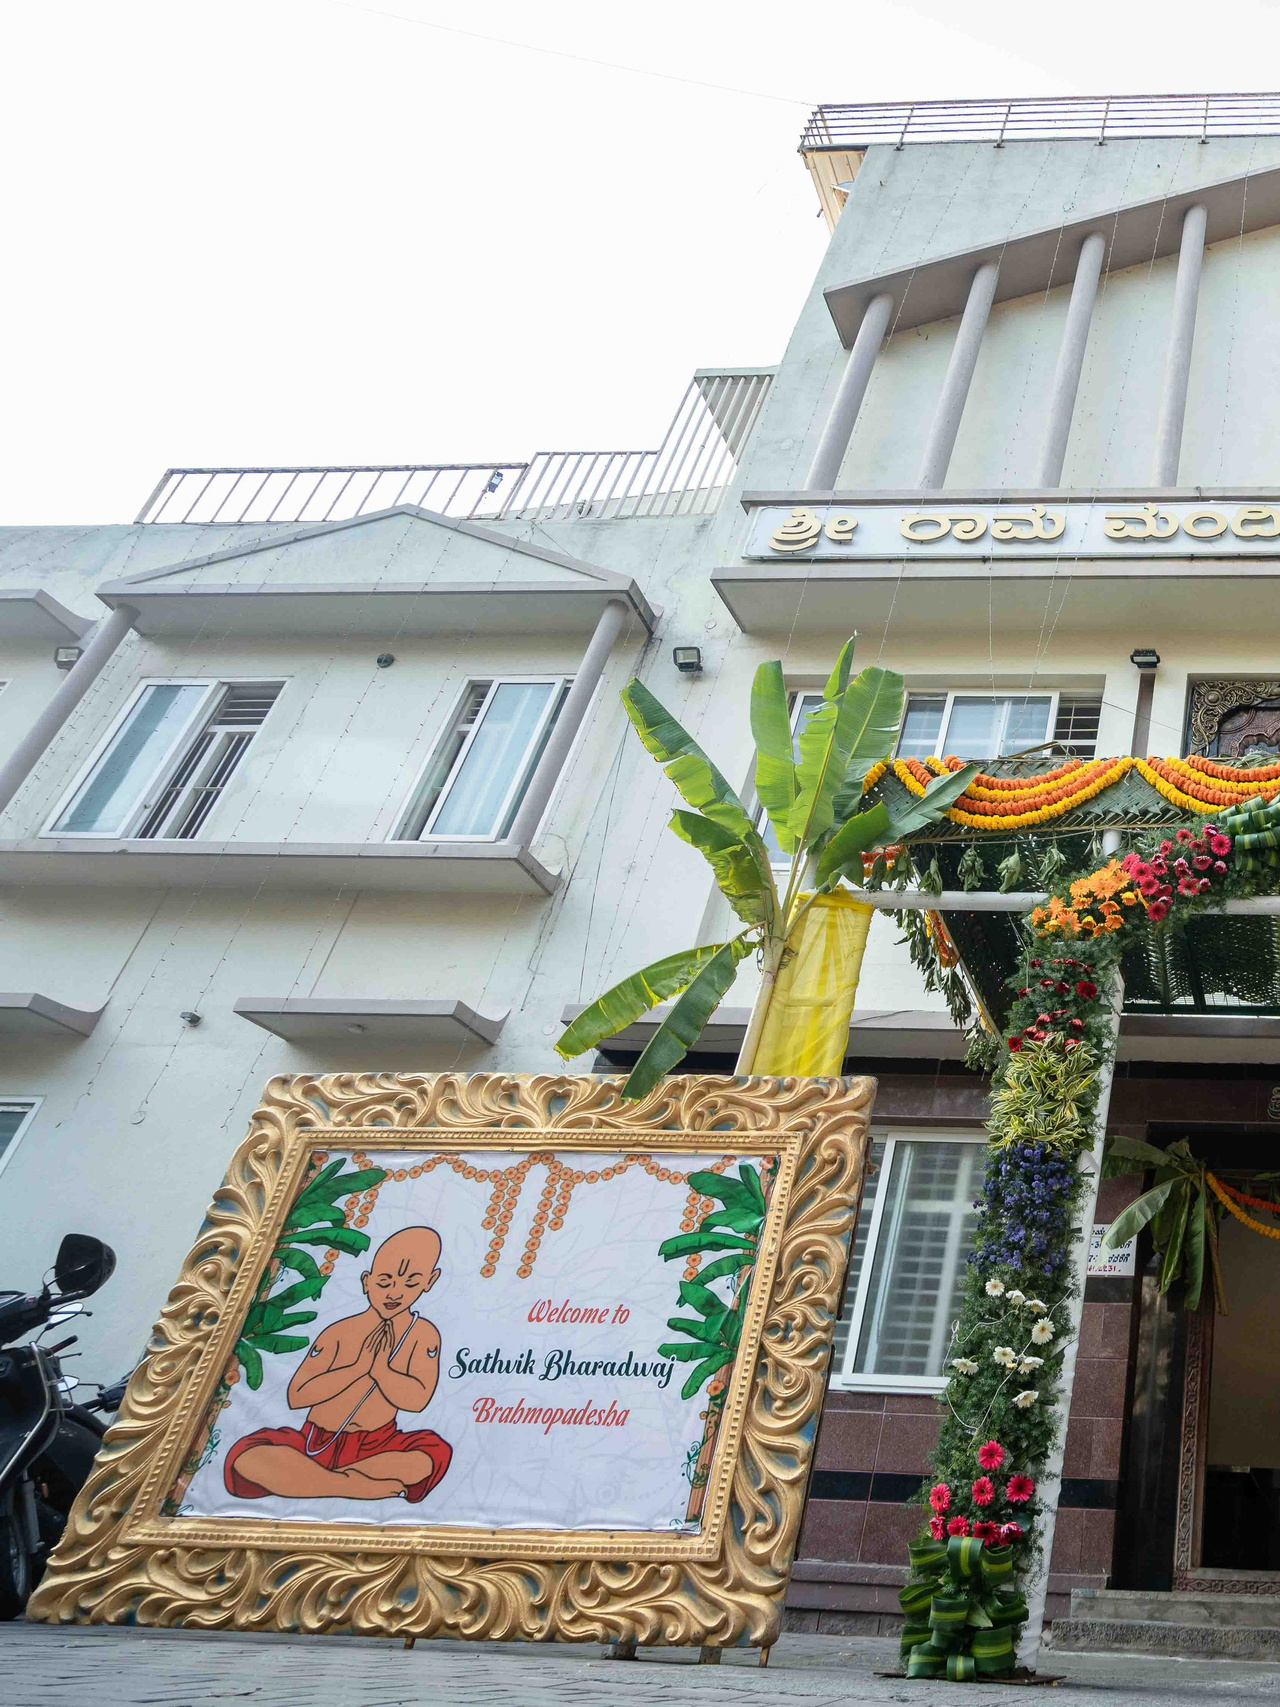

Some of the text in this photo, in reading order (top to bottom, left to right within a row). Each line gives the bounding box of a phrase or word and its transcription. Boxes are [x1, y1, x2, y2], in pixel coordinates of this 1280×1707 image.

[767, 505, 859, 553] ಶ್ರೀ
[900, 503, 1066, 543] ರಾಮ
[527, 1298, 630, 1325] Welcome to
[448, 1347, 677, 1389] Sathvik Bharadwaj
[471, 1397, 631, 1435] Brahmopadesha
